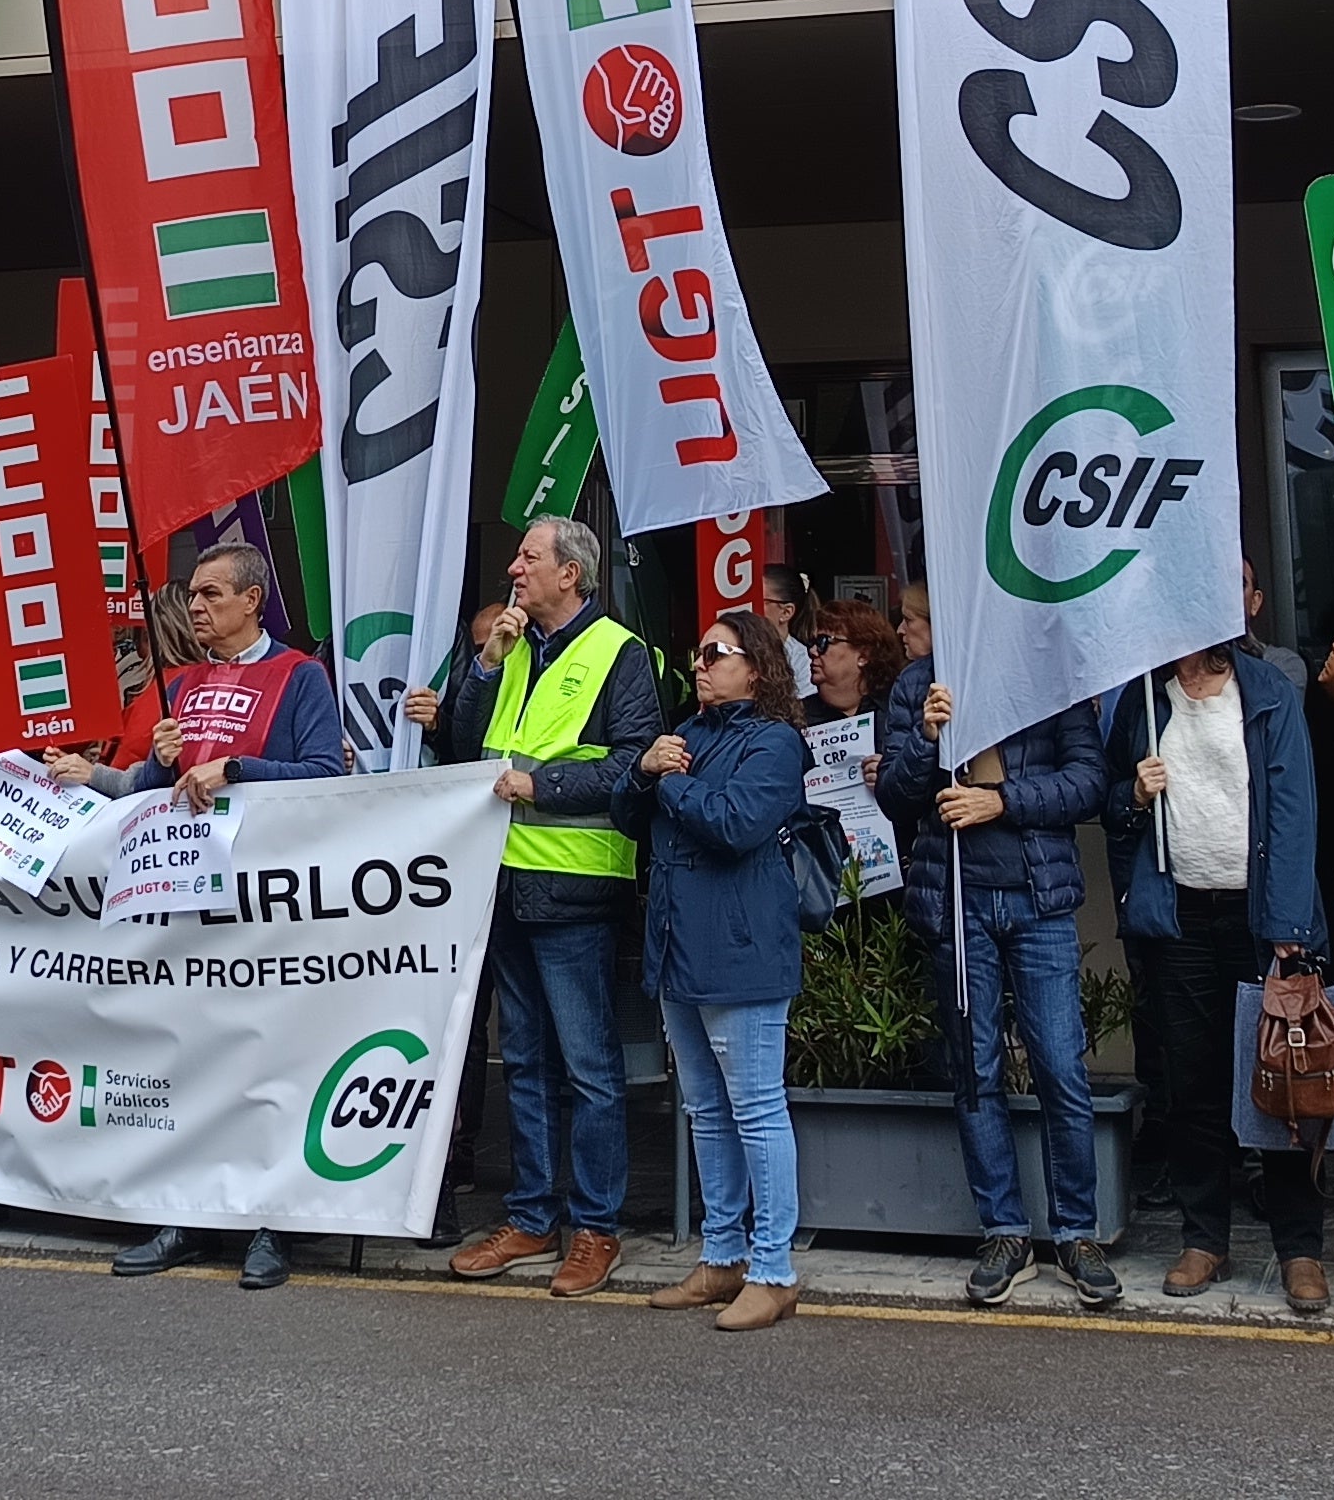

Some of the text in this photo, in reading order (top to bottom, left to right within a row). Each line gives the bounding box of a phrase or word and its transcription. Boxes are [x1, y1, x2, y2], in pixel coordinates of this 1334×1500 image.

[610, 187, 738, 467] UGT
[148, 328, 304, 371] enseñanza
[157, 362, 309, 436] JAÉN
[523, 371, 587, 518] SIF
[1022, 451, 1205, 529] CSIF
[21, 717, 75, 739] Jaén
[821, 732, 859, 746] ROBO
[824, 750, 847, 765] CRP
[0, 780, 70, 829] NO AL ROBO
[0, 812, 45, 844] DEL CRP
[120, 822, 211, 859] NO AL ROBO
[131, 850, 200, 874] DEL CRP
[136, 882, 160, 895] UGT
[8, 946, 28, 975] Y
[29, 948, 175, 987] CARRERA
[185, 943, 439, 988] PROFESIONAL
[105, 1070, 171, 1090] Servicios
[105, 1091, 170, 1109] Públicos
[329, 1076, 434, 1130] CSIF
[106, 1112, 175, 1132] Andalucía
